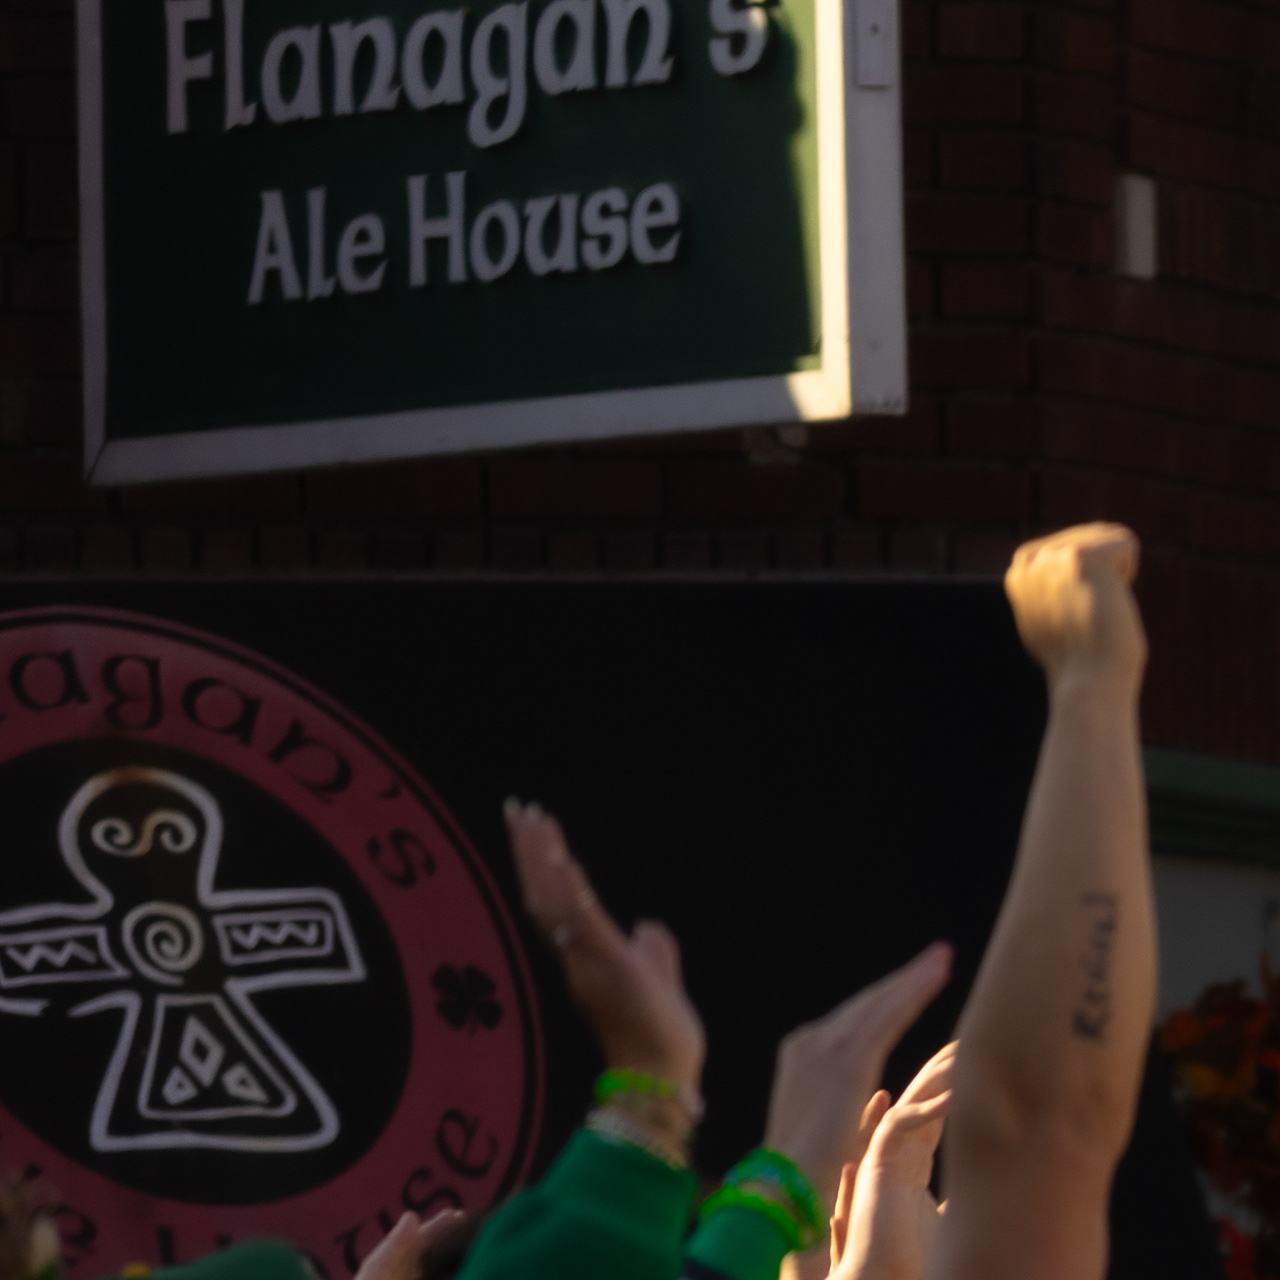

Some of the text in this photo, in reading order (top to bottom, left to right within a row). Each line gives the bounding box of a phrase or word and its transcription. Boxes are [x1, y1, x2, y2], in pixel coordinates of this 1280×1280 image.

[164, 0, 771, 149] Flanagans
[247, 169, 683, 306] Ale House
[0, 649, 437, 888] agan's
